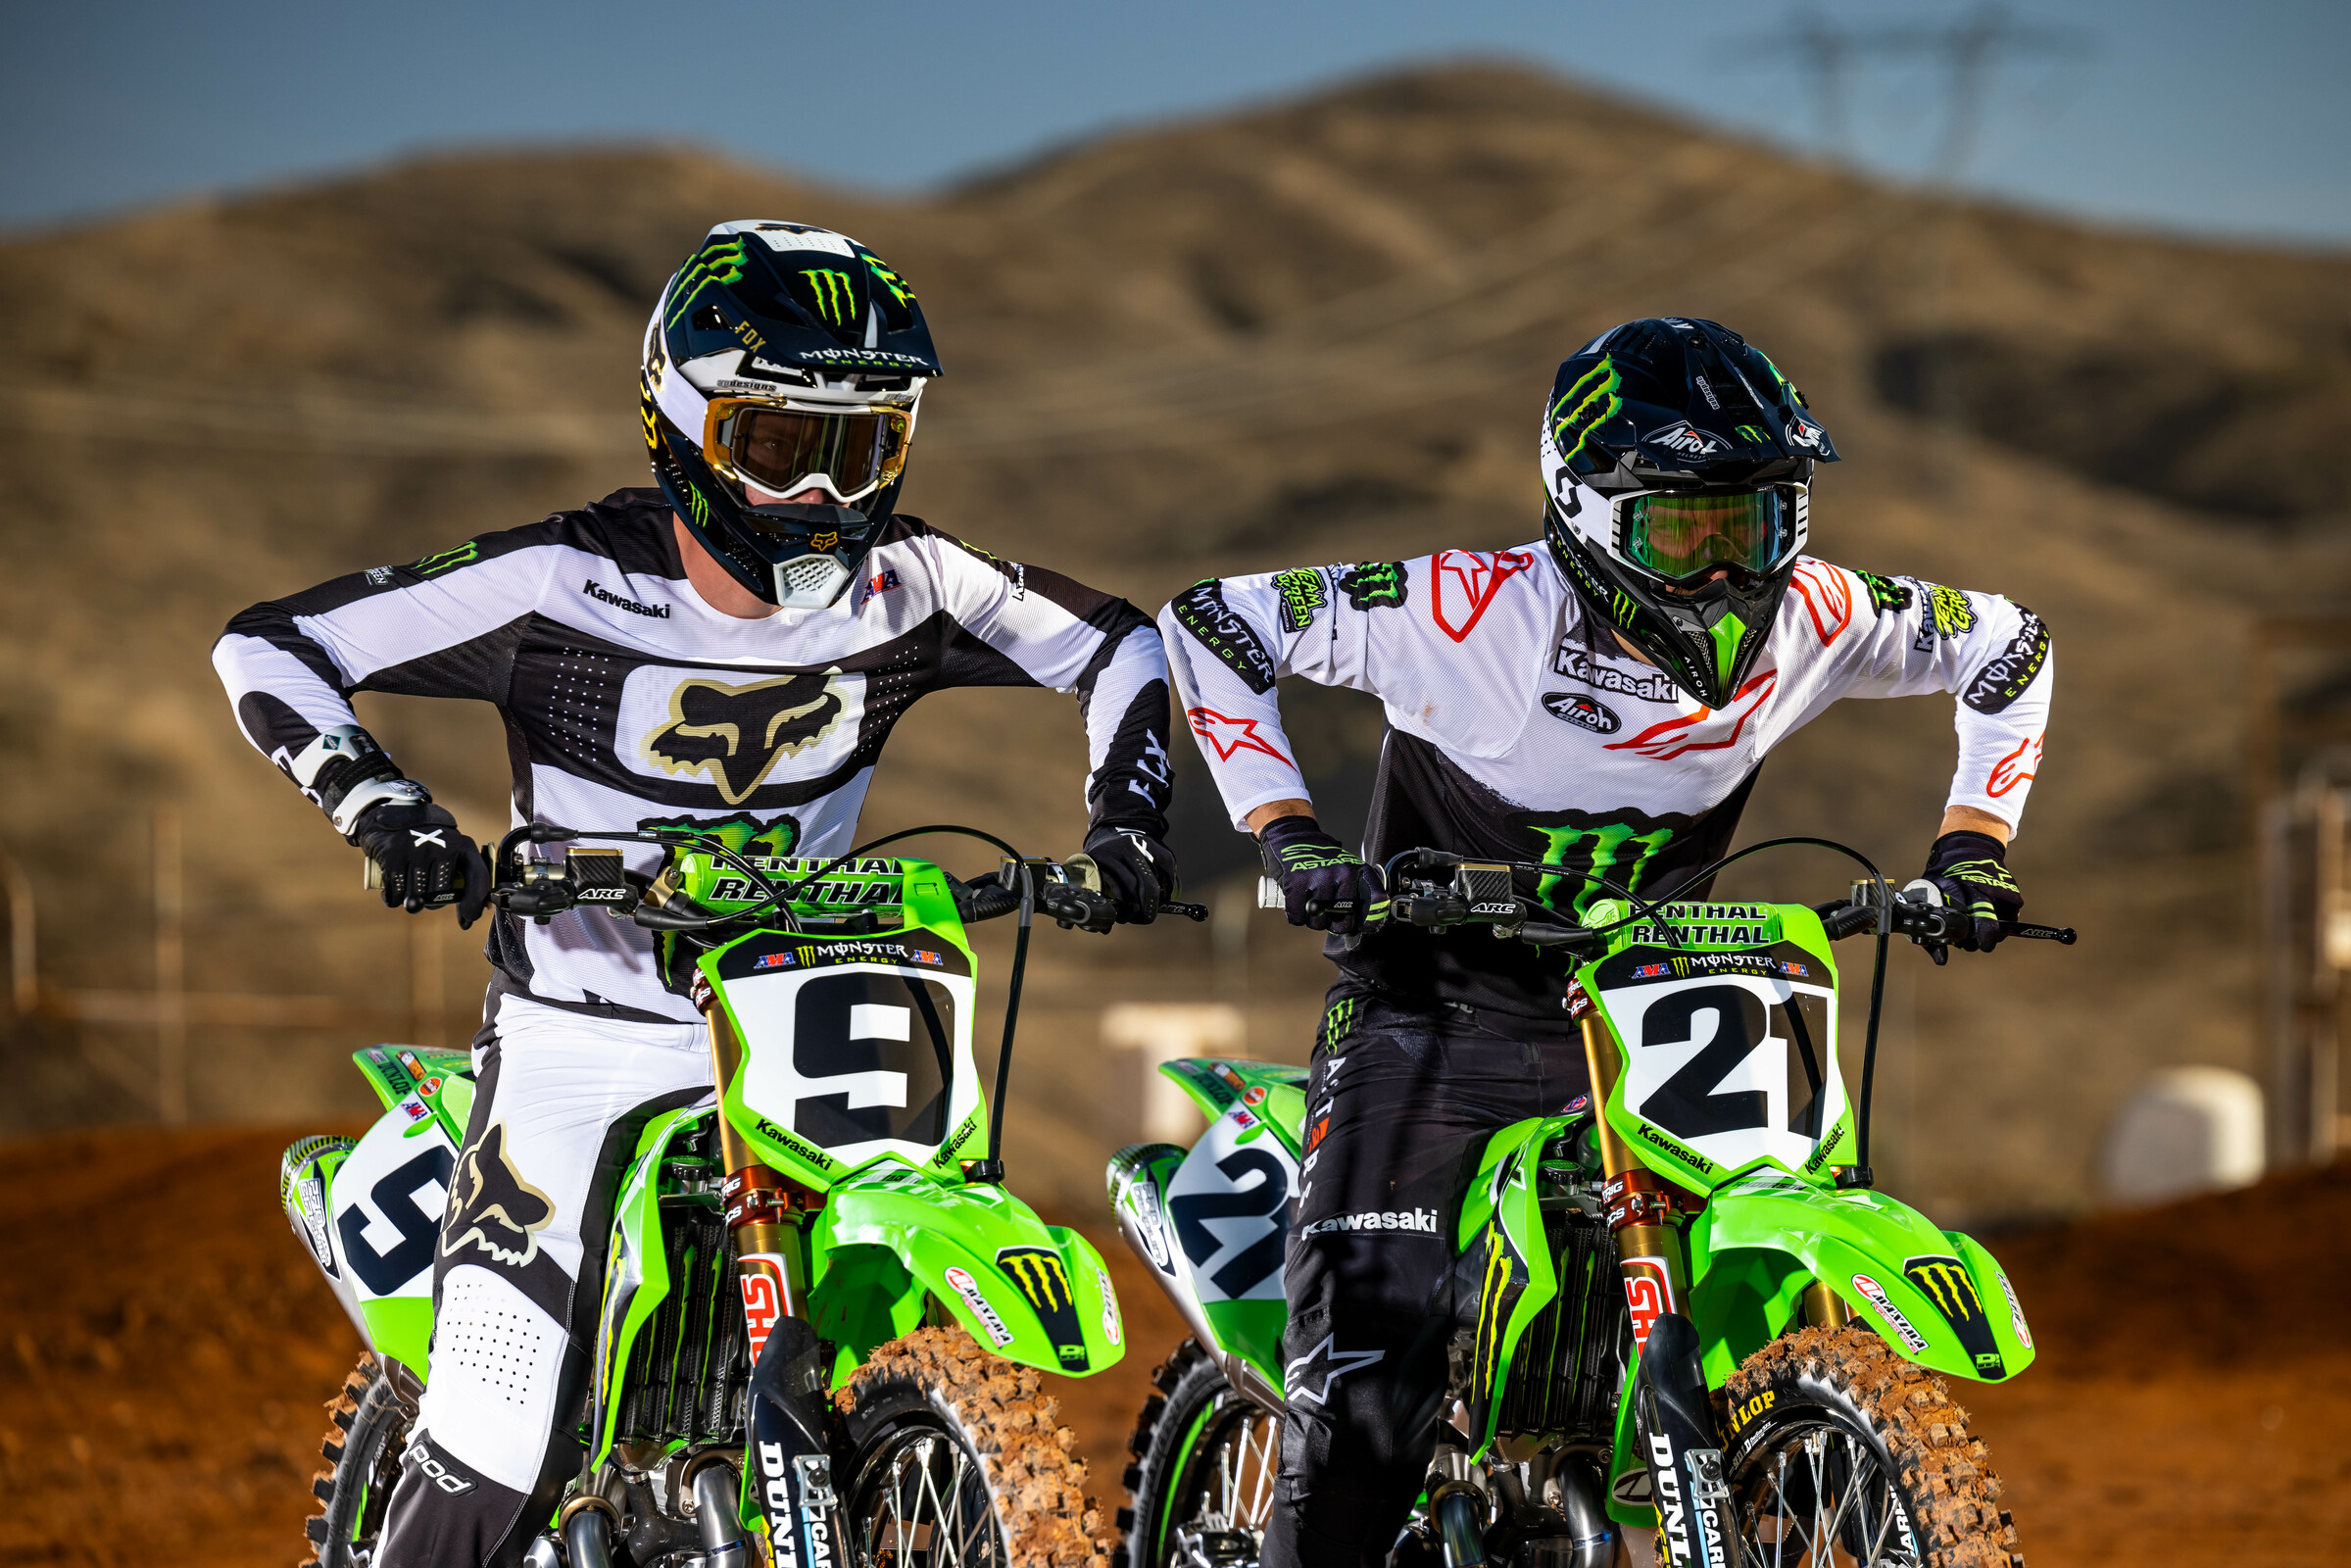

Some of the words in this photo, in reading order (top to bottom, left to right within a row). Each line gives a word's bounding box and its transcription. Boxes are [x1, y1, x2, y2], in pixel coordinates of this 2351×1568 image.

[735, 320, 767, 353] FOX
[798, 348, 929, 367] MONSTER
[826, 359, 913, 368] ENERGY
[1291, 567, 1324, 608] TEAM
[1556, 539, 1598, 596] ENERGY
[582, 579, 670, 619] Kawasaki
[1278, 572, 1311, 628] GREEN
[1178, 605, 1248, 669] ENERGY
[1191, 587, 1274, 683] MONSTER
[1555, 646, 1679, 704] Kawasaki
[1684, 657, 1707, 697] AIROH
[2004, 630, 2049, 698] ENERGY
[1548, 697, 1613, 730] Airoh
[433, 893, 455, 902] ARC
[577, 888, 627, 901] ARC
[1471, 902, 1516, 914] ARC
[2021, 928, 2054, 938] ARC
[754, 952, 796, 969] AMA
[817, 941, 908, 958] MONSTER
[910, 949, 944, 966] AMA
[835, 956, 898, 964] ENERGY
[1632, 962, 1671, 978] AMA
[1690, 953, 1777, 969] MONSTER
[1779, 960, 1809, 977] AMA
[1708, 967, 1768, 976] ENERGY
[793, 971, 955, 1149] 9
[1640, 984, 1828, 1141] 21
[755, 1118, 835, 1172] Kawasaki
[933, 1117, 978, 1170] Kawasaki
[1637, 1123, 1714, 1175] Kawasaki
[1804, 1123, 1845, 1175] Kawasaki
[1300, 1207, 1438, 1243] Kawasaki
[1872, 1292, 1927, 1349] MAXIMA
